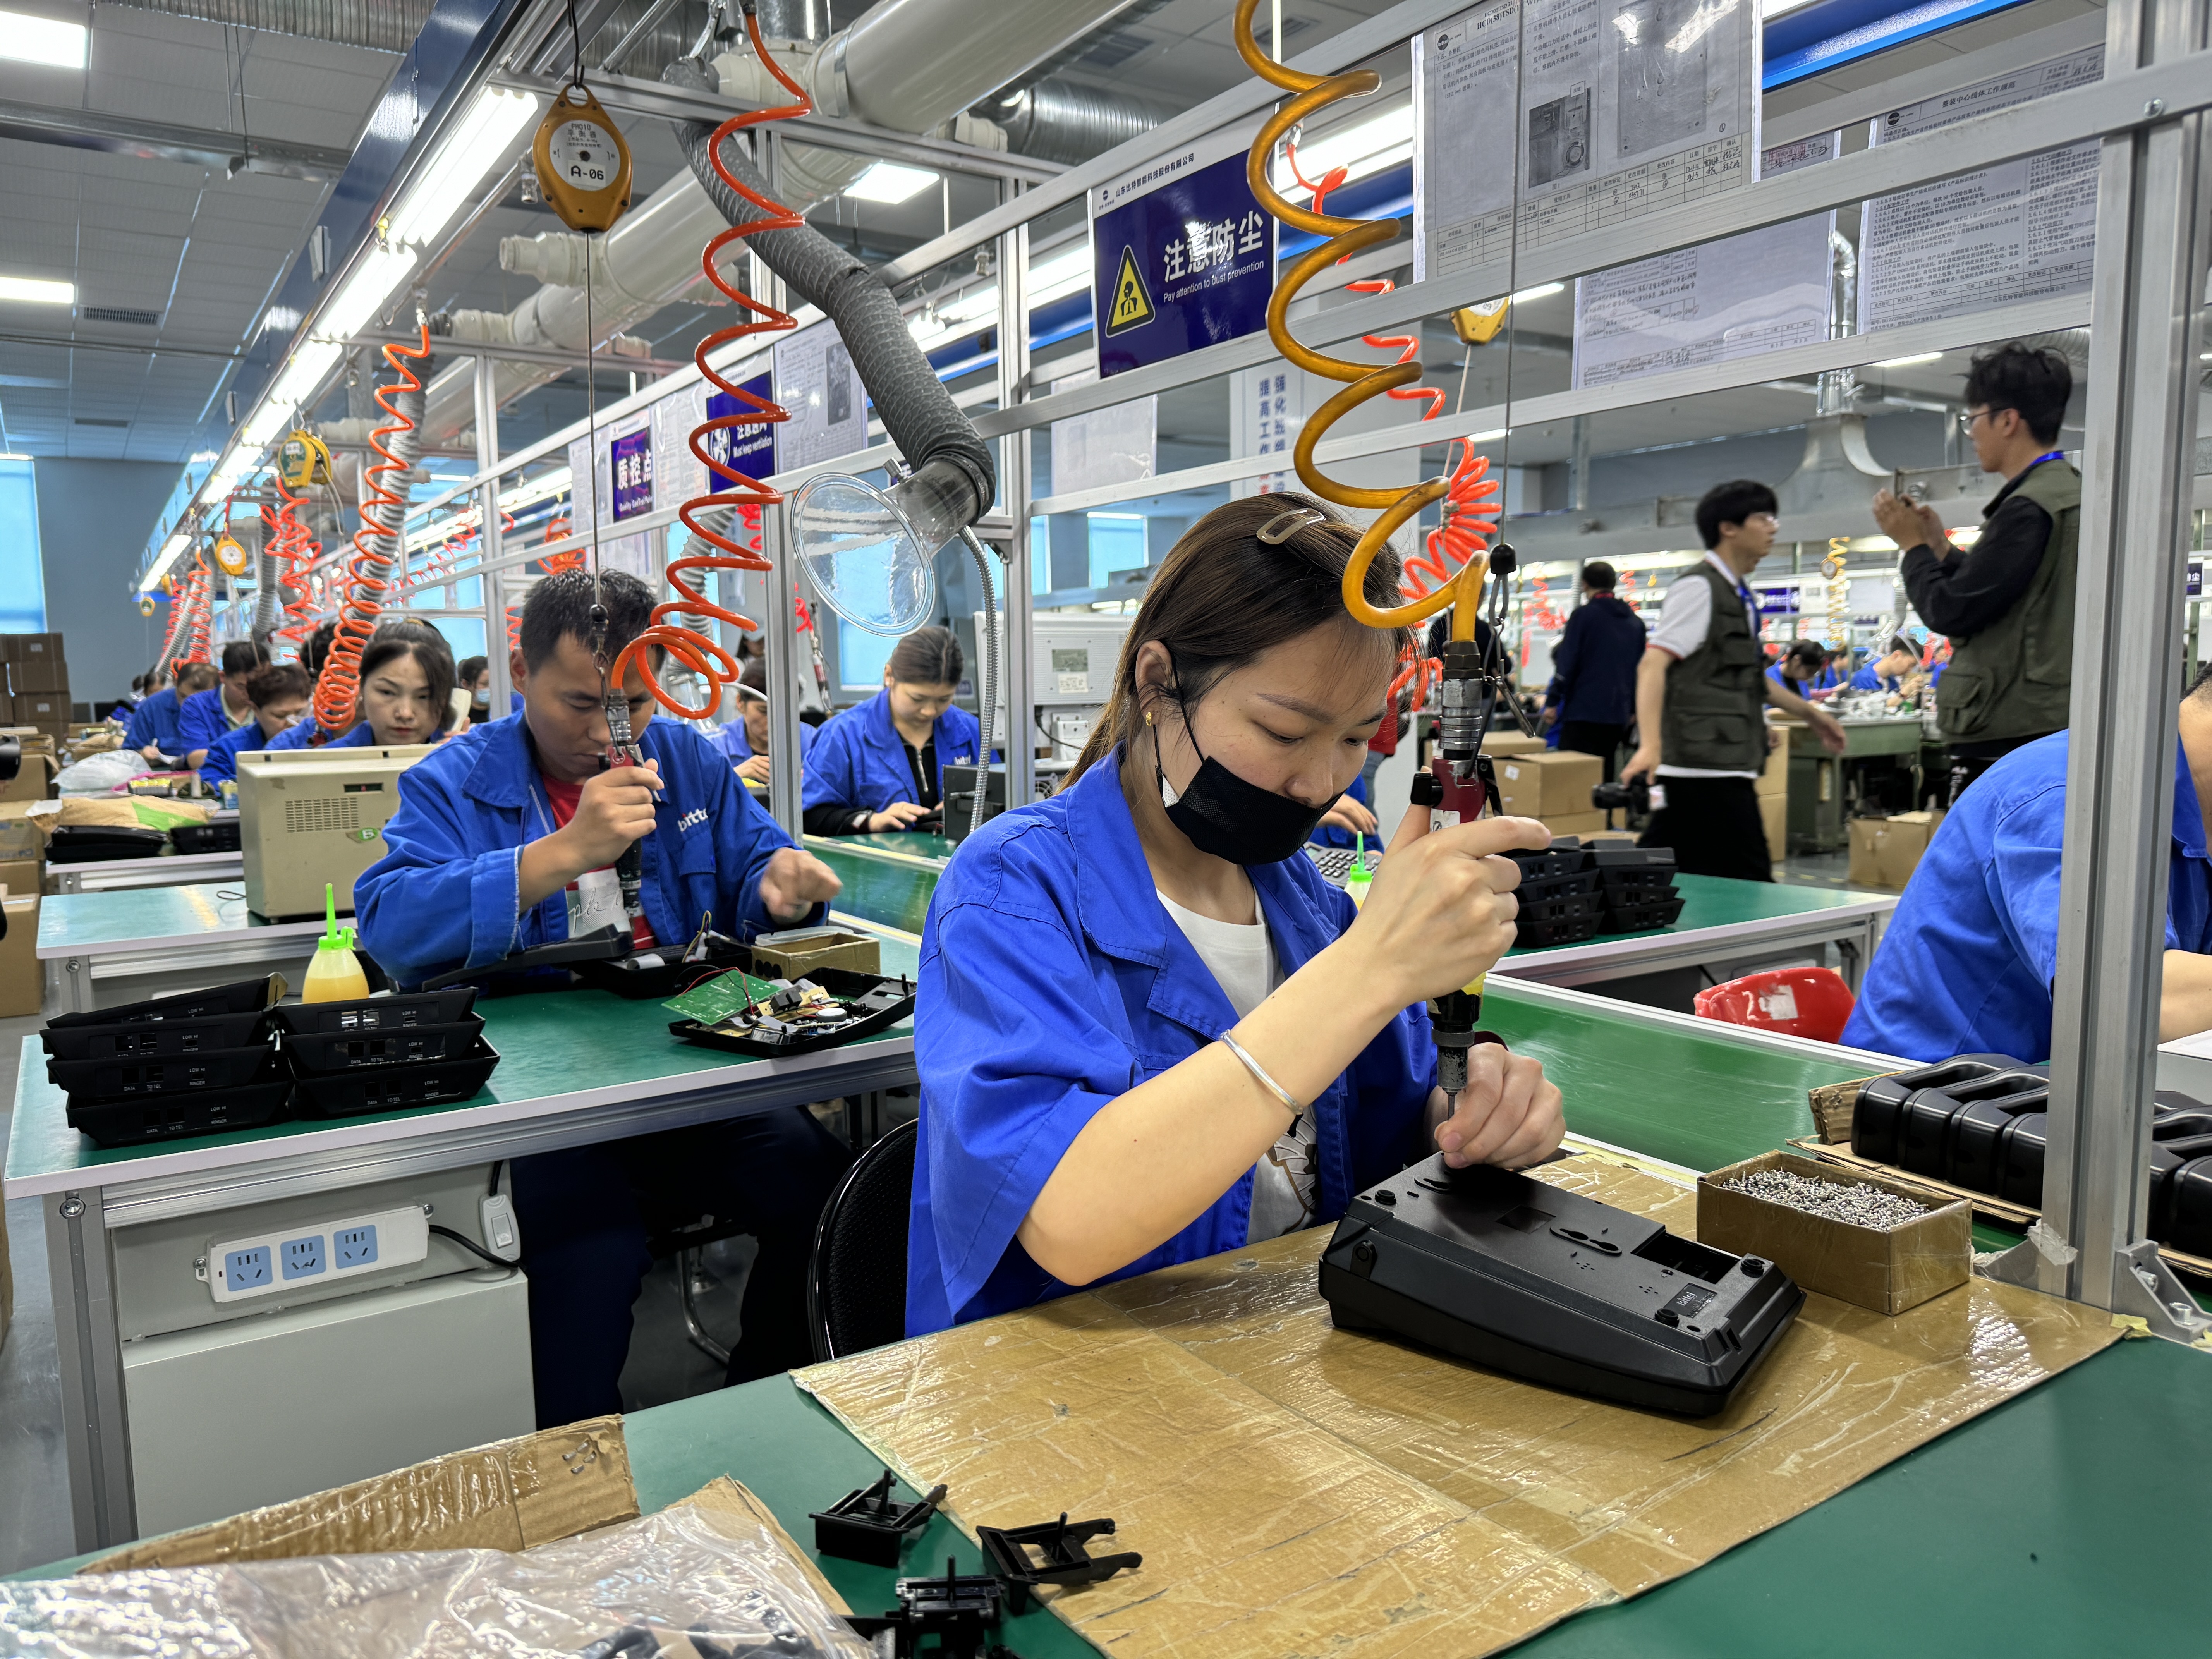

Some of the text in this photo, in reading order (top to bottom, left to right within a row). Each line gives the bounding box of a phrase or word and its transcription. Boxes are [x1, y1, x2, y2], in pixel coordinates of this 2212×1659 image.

[571, 165, 604, 180] A-06
[1116, 153, 1194, 197] 山东比特智能科技股份有限公司
[1163, 210, 1264, 283] 注意防尘
[1164, 260, 1264, 303] Pay attention to dust prevention
[743, 442, 752, 455] keep
[752, 435, 773, 452] ventilation
[618, 448, 651, 490] 质控点
